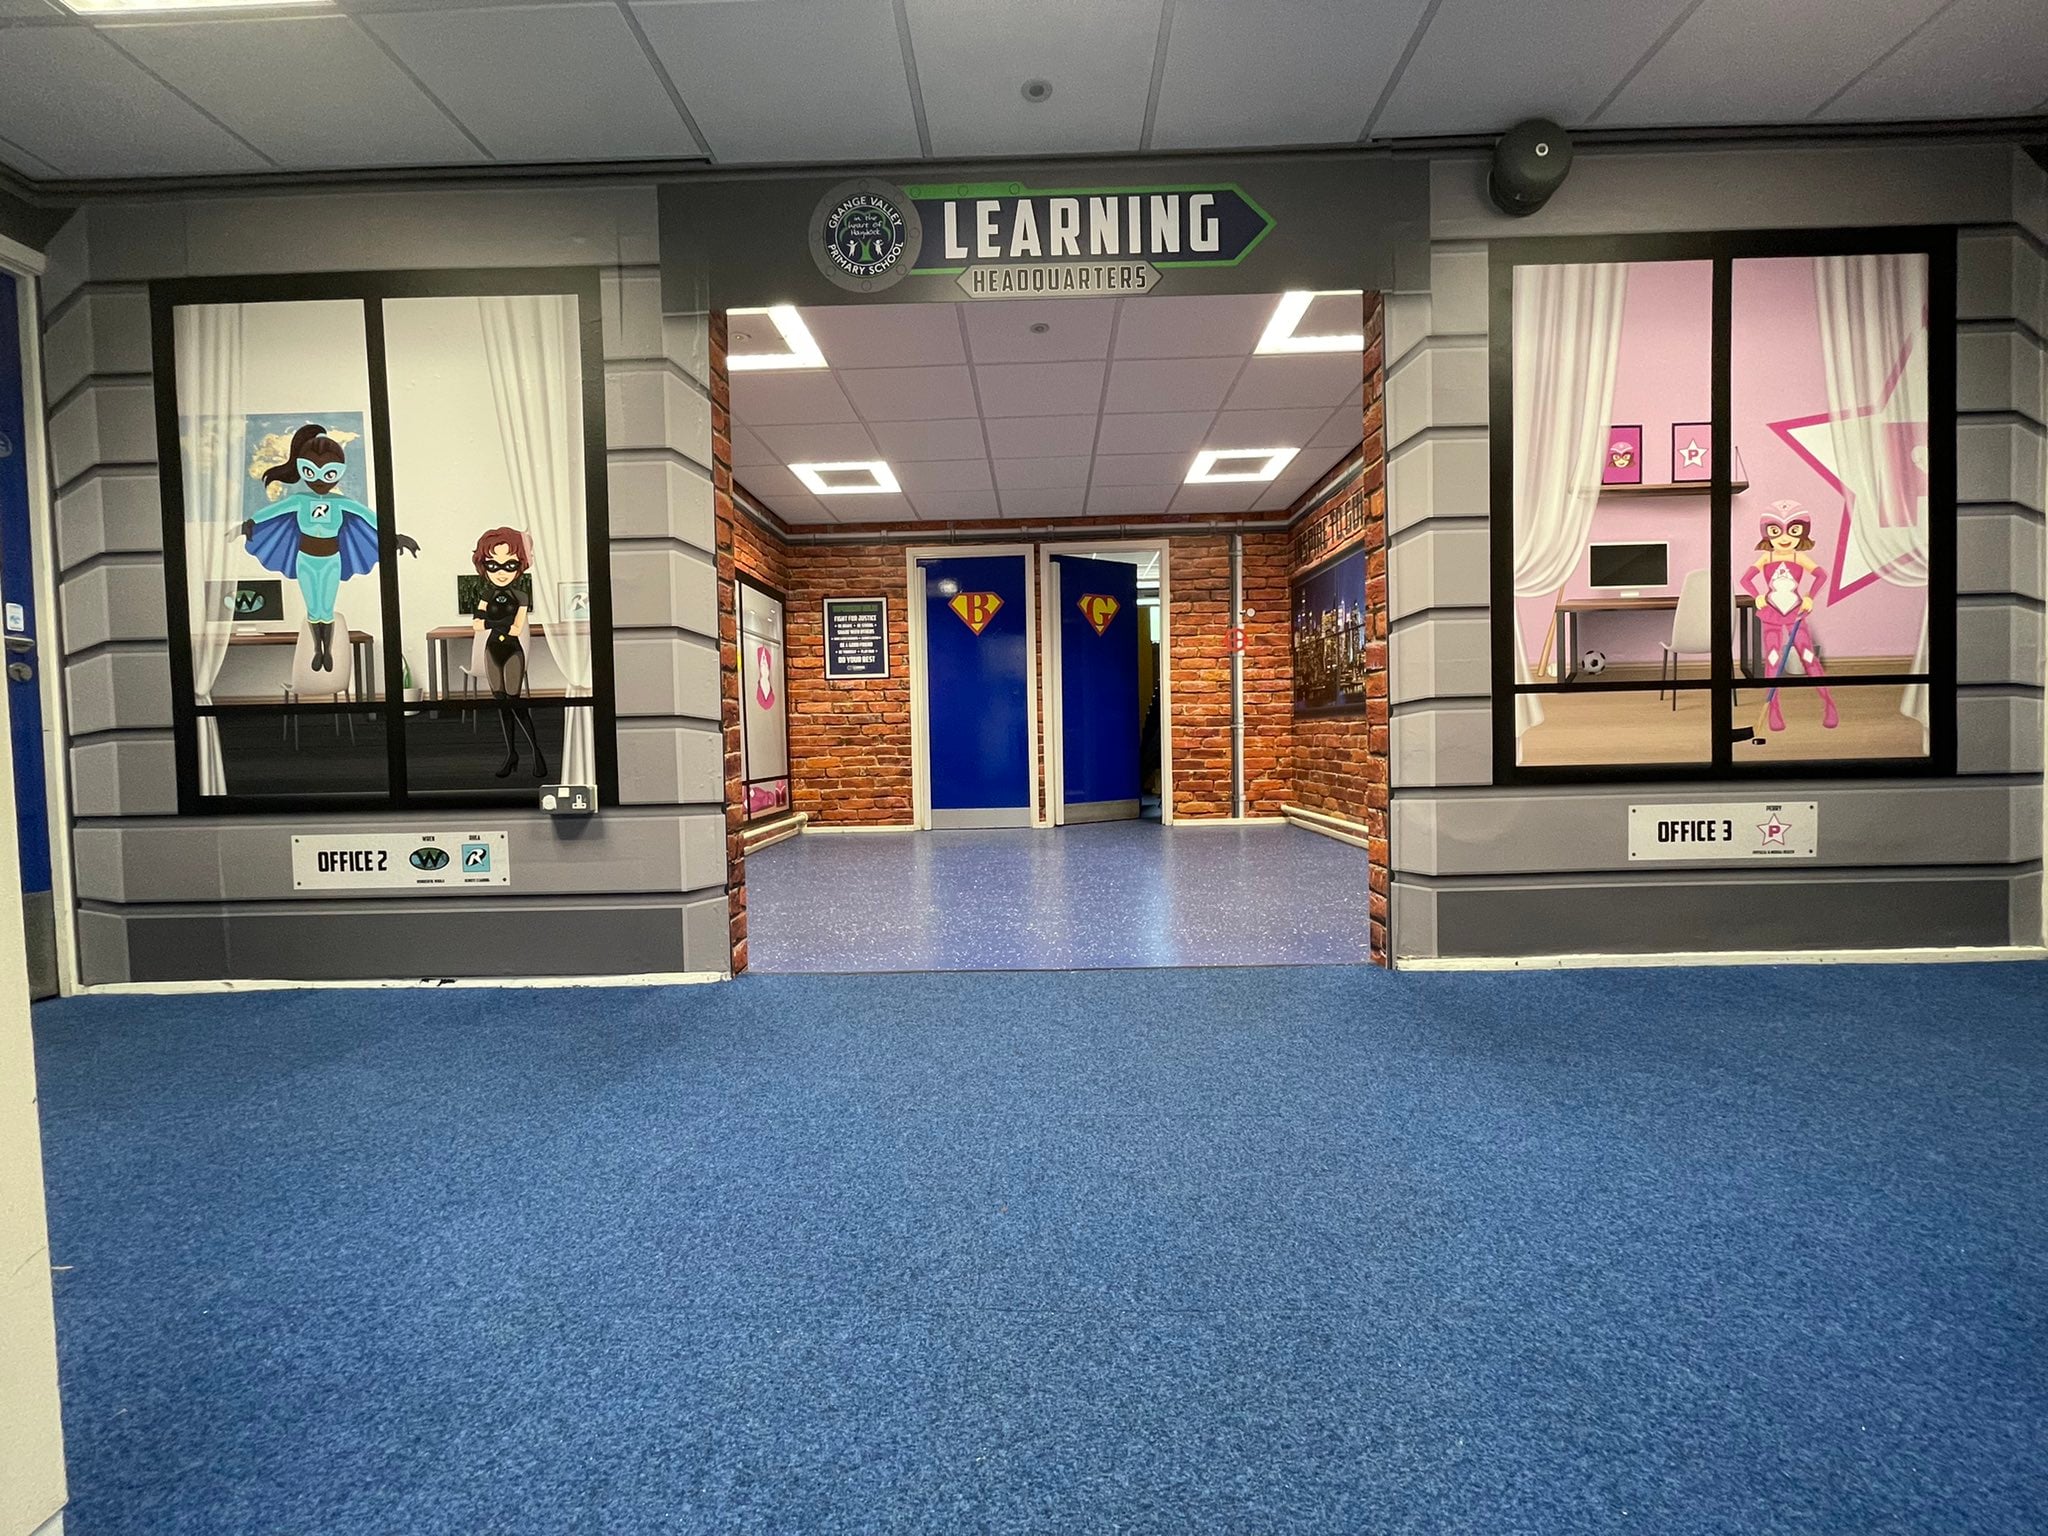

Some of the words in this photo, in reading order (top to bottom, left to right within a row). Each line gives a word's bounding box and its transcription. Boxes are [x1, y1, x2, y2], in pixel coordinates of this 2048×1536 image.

[828, 196, 867, 229] GRANGE
[870, 197, 903, 226] VALLEY
[943, 193, 1220, 259] LEARNING
[828, 243, 866, 275] PRIMARY
[868, 241, 904, 275] SCHOOL
[972, 264, 1148, 294] HEADQUARTERS
[966, 593, 992, 625] B
[1086, 596, 1112, 626] G
[1657, 820, 1717, 843] OFFICE
[1722, 819, 1733, 841] 3
[1768, 825, 1781, 838] P
[317, 851, 374, 873] OFFICE
[377, 850, 388, 872] 2
[465, 847, 487, 867] R
